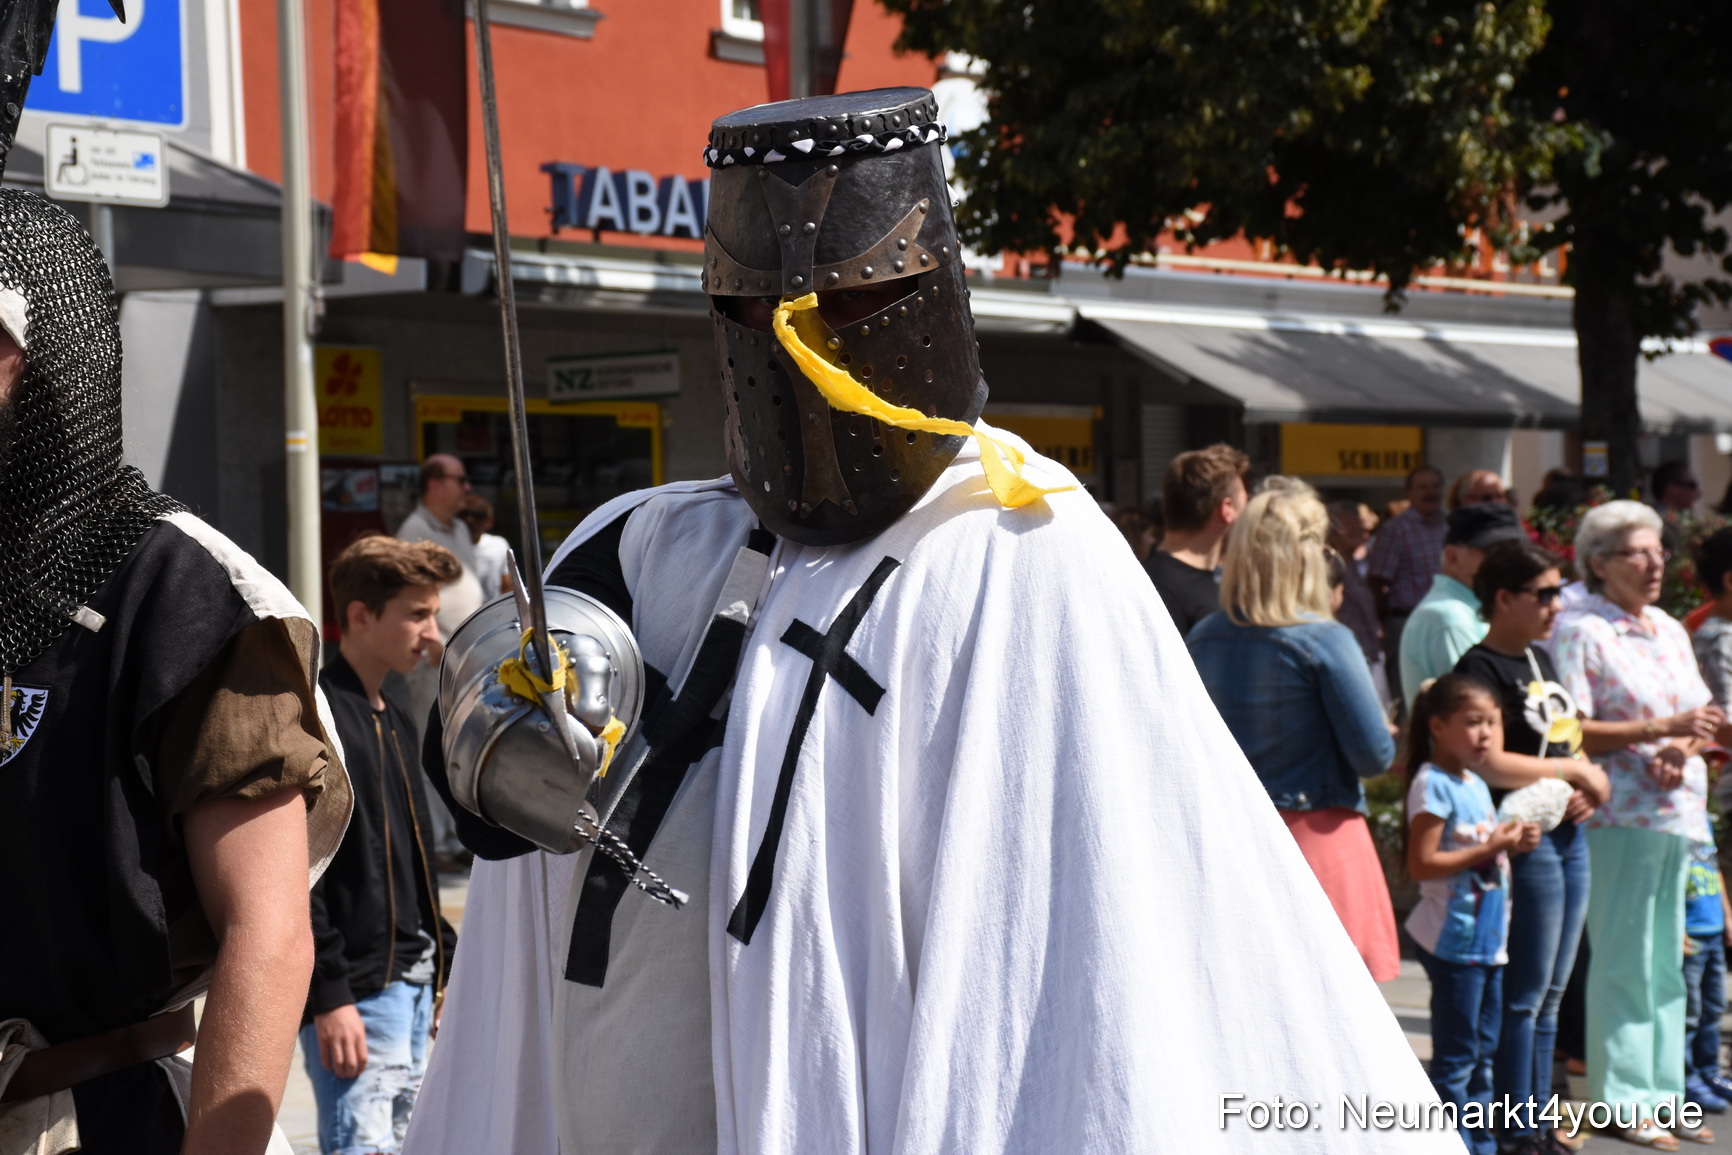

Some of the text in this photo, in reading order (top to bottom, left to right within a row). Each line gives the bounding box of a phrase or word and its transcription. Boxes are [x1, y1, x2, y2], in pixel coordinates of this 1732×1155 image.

[57, 0, 145, 94] P
[540, 161, 711, 240] TABA
[554, 367, 594, 393] NZ
